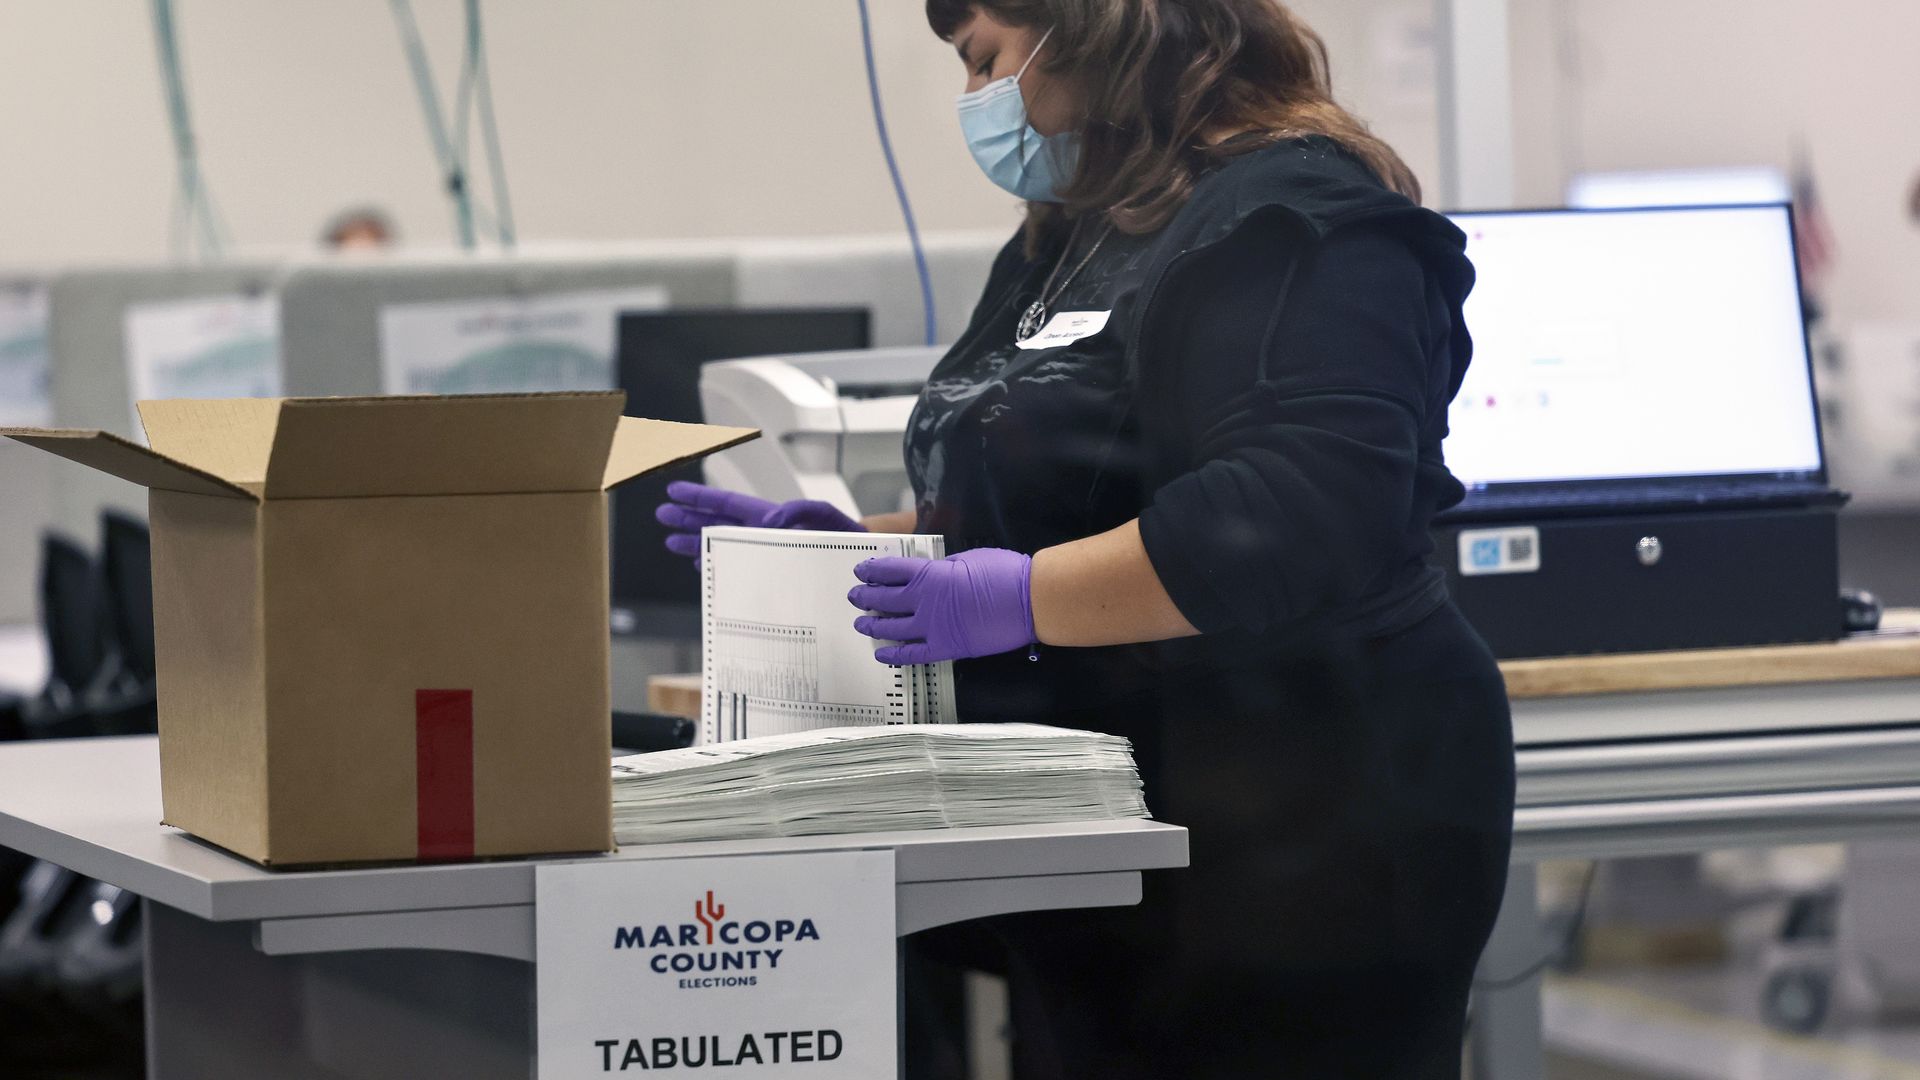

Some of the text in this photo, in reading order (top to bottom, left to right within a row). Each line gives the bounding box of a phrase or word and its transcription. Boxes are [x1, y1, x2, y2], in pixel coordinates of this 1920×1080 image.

[649, 949, 783, 974] COUNTY
[679, 976, 757, 988] ELECTIONS
[595, 1029, 843, 1072] TABULATED
